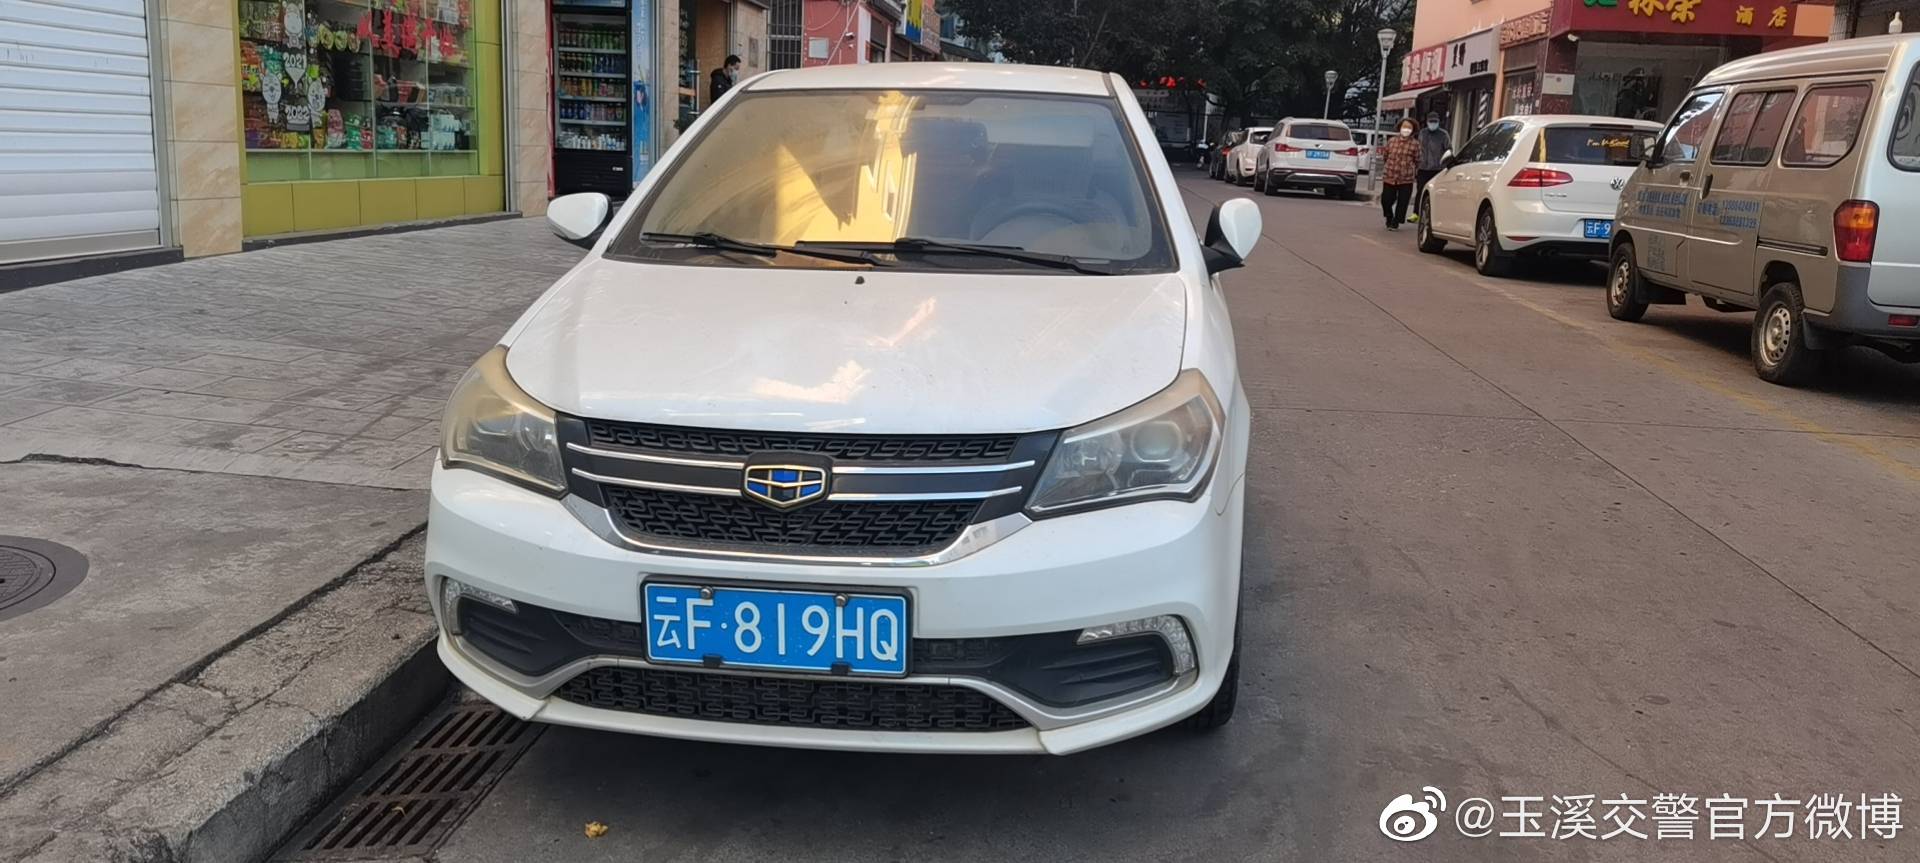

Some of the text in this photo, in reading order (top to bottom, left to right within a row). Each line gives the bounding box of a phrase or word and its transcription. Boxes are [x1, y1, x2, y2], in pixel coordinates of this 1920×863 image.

[1736, 5, 1787, 27] 酒店
[283, 52, 306, 68] 2021
[285, 105, 309, 119] 2022
[1586, 222, 1612, 235] 云F·9
[653, 596, 898, 662] 云F·819HQ
